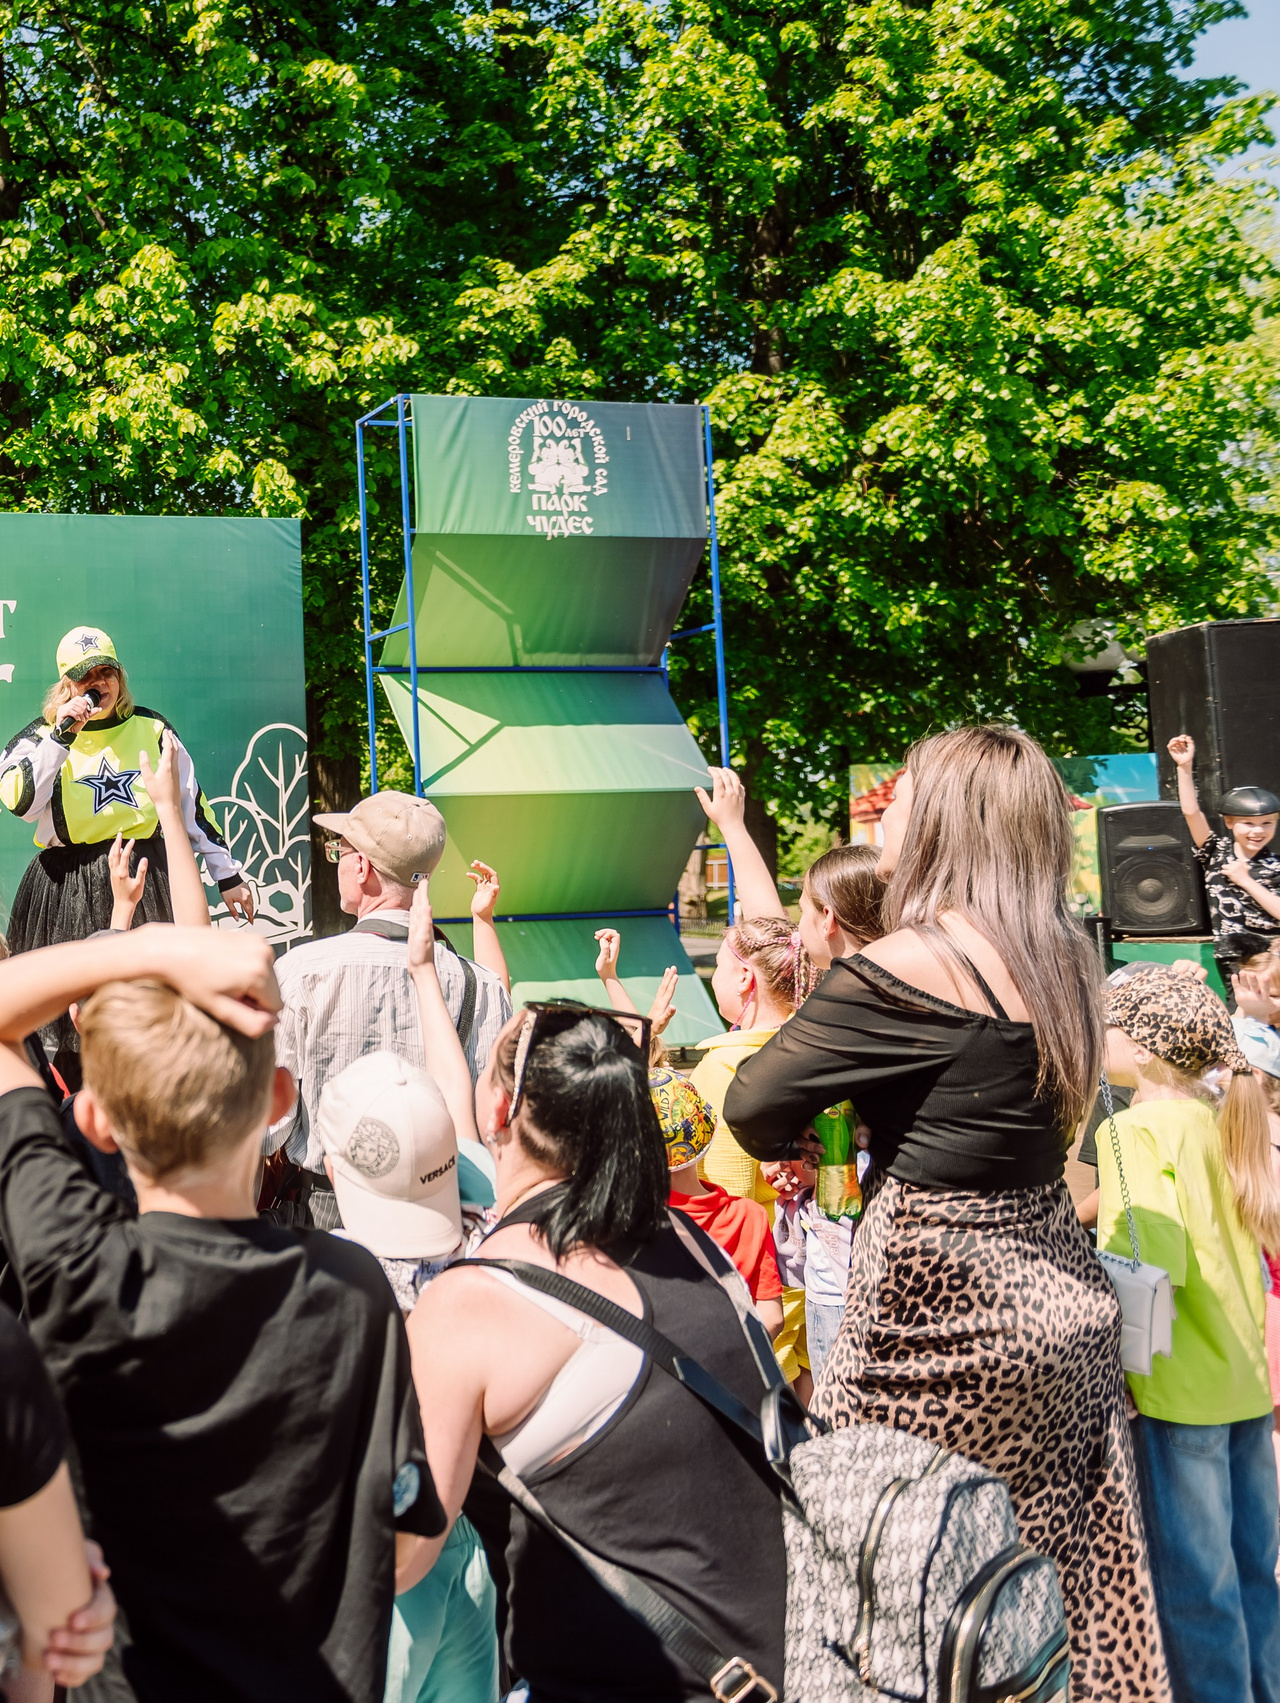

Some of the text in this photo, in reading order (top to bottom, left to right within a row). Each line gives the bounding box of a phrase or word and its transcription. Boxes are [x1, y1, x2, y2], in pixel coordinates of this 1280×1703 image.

[532, 415, 566, 437] 100
[532, 494, 588, 519] ПАРК
[526, 515, 594, 540] ЧУДЕС
